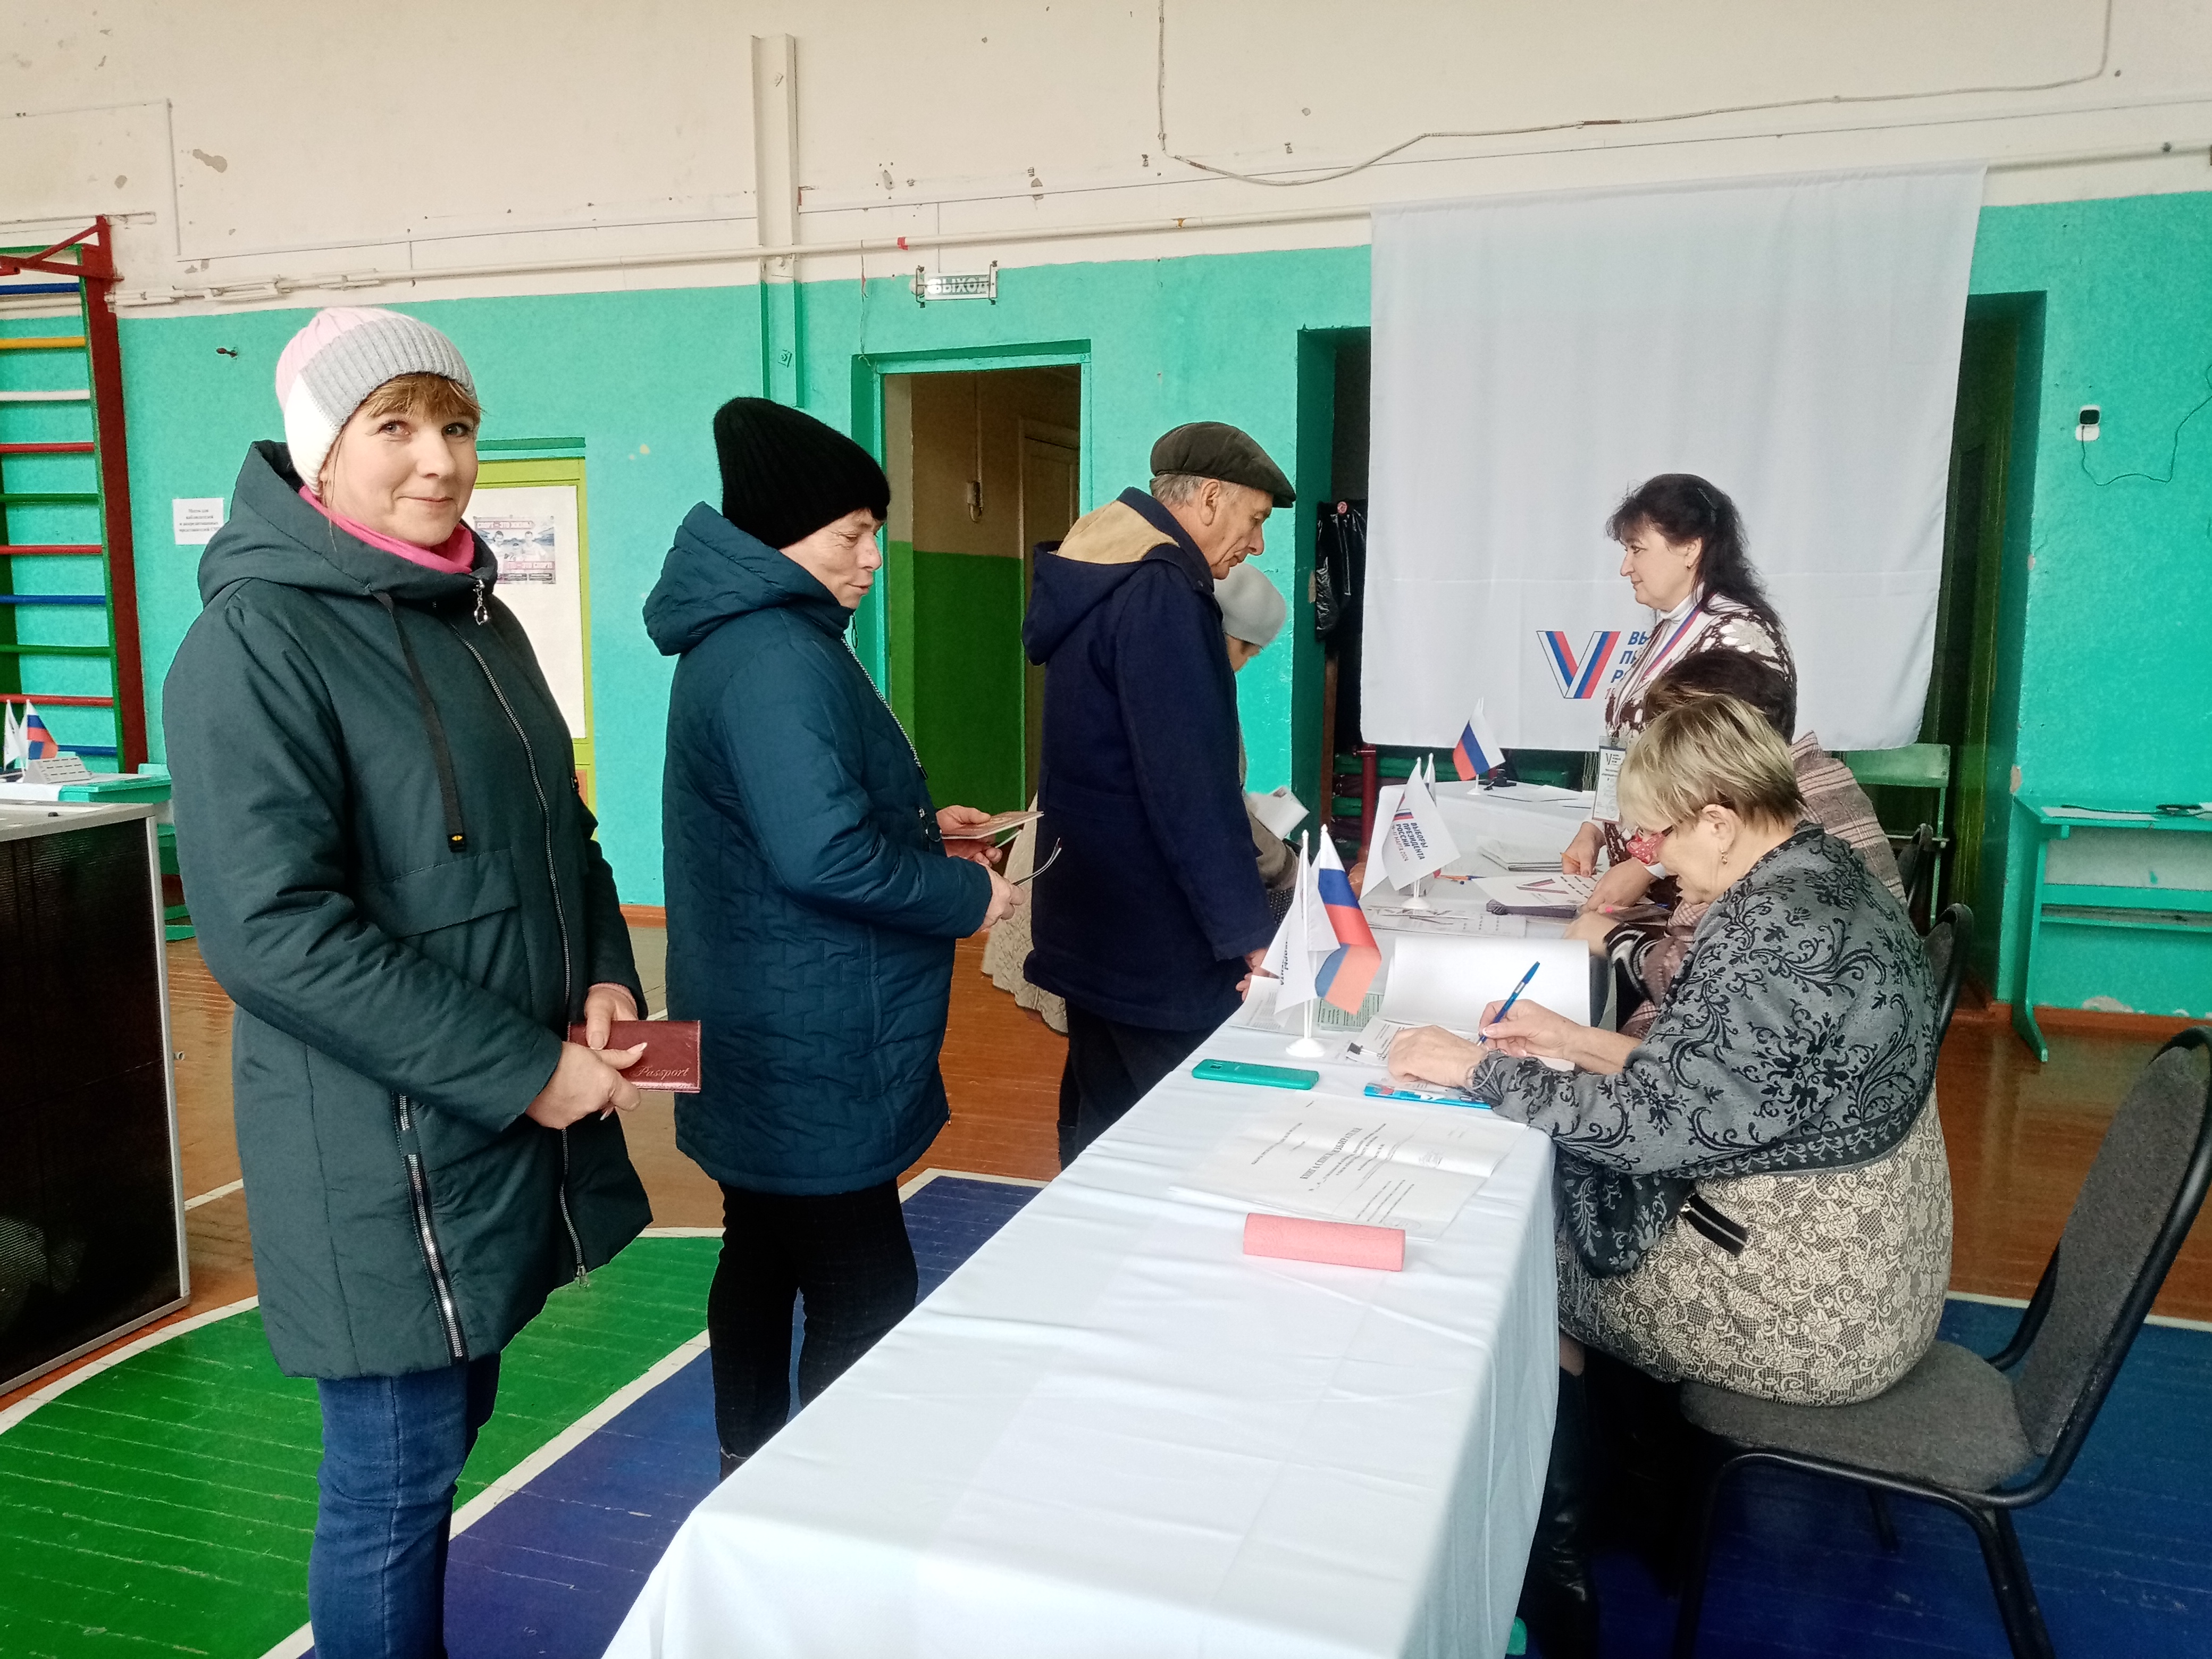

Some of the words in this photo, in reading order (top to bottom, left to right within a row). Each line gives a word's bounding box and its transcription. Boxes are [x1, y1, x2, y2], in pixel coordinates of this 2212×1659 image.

[927, 276, 989, 294] ВЫХОД
[1396, 824, 1410, 847] РОССИИ
[1402, 823, 1425, 860] ПРЕЗИДЕНТА
[1411, 823, 1428, 848] ВЫБОРЫ
[630, 1065, 690, 1080] Passport
